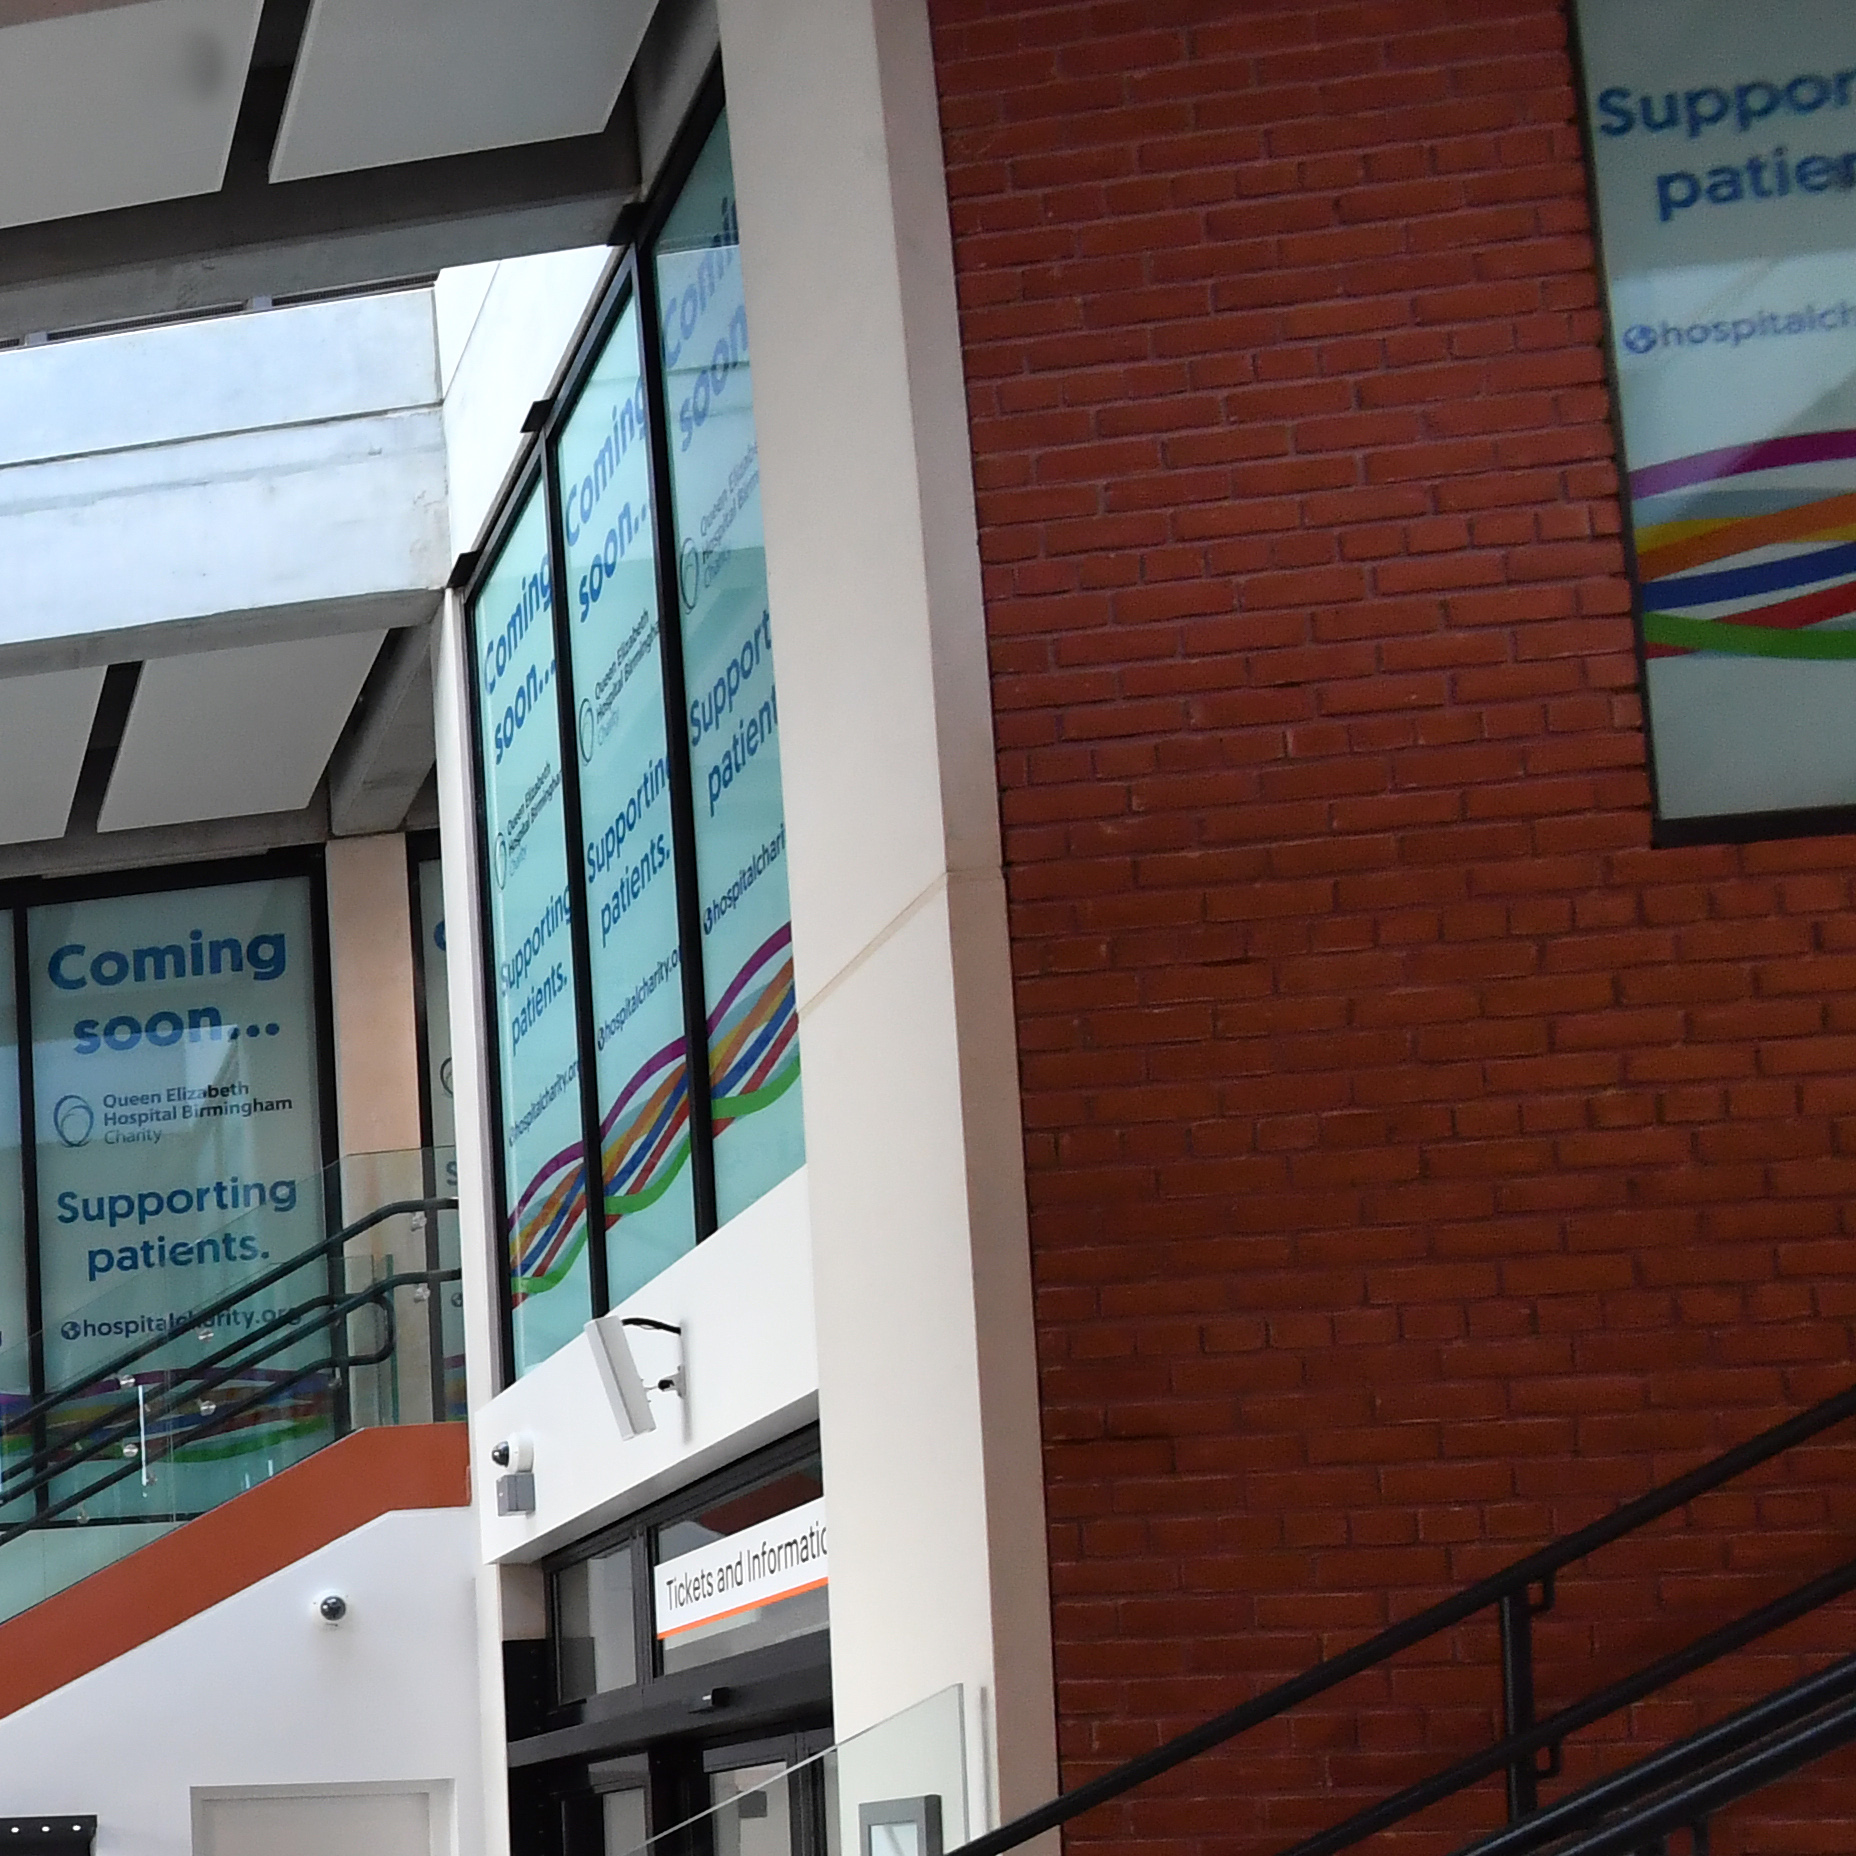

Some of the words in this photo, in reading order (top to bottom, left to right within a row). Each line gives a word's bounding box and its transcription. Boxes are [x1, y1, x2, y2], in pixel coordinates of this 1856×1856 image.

[600, 833, 671, 949] patients.
[48, 928, 286, 991] Coming
[73, 1006, 280, 1055] soon...
[511, 961, 568, 1057] patients.
[103, 1092, 162, 1110] Queen
[166, 1080, 249, 1102] Elizabeth
[103, 1106, 177, 1128] Hospital
[182, 1098, 293, 1120] Birmingham
[104, 1127, 163, 1145] Charity
[57, 1176, 297, 1228] Supporting
[87, 1232, 270, 1282] patients.
[666, 1568, 714, 1611] Tickets
[717, 1551, 744, 1594] and
